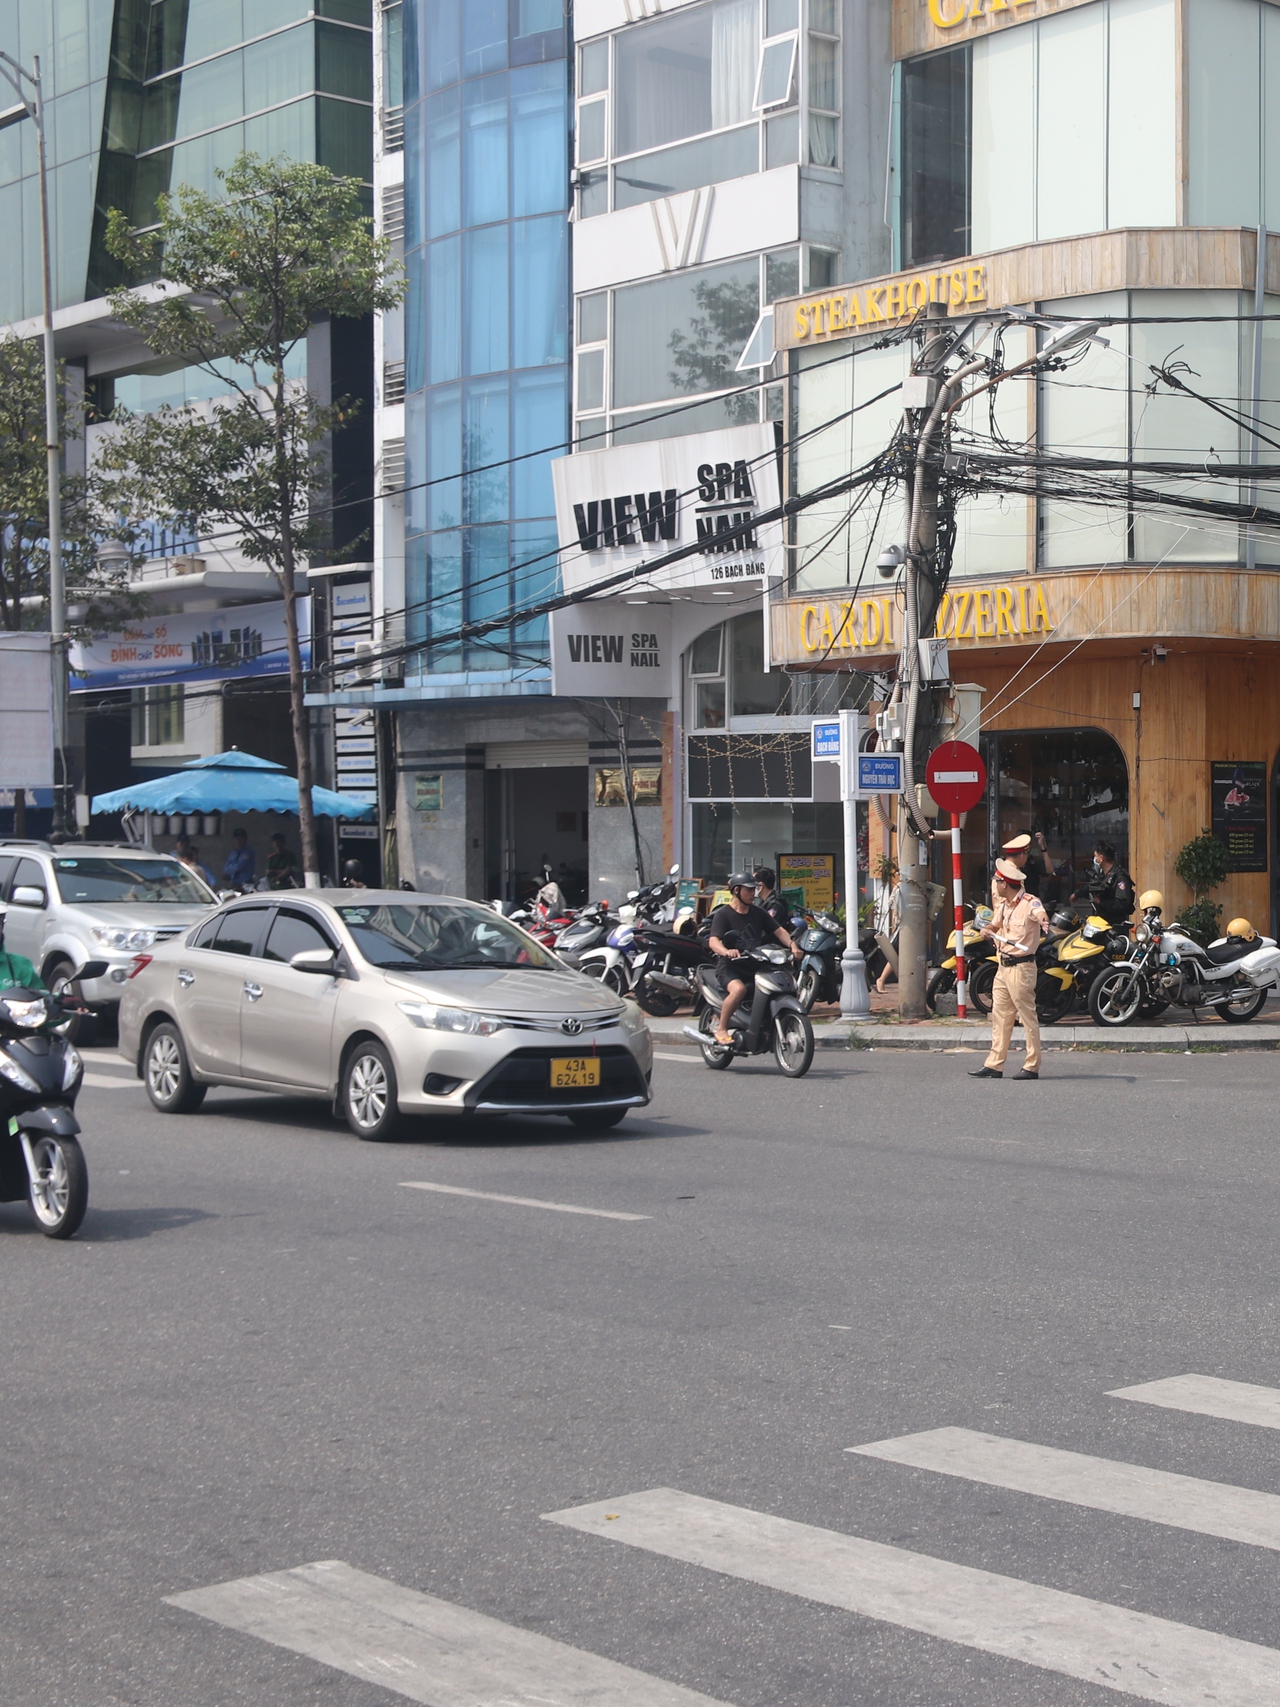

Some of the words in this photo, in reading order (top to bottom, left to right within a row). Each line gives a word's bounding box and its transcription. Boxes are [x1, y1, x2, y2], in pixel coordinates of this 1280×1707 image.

[794, 265, 985, 339] STEAKHOUSE
[697, 459, 755, 503] SPA
[573, 488, 682, 552] VIEW
[696, 511, 761, 555] NAIL
[710, 568, 724, 580] 126
[800, 598, 895, 651] CARDI
[110, 642, 137, 663] ĐỈNH
[153, 640, 184, 659] SỐNG
[567, 634, 624, 663] VIEW
[631, 633, 658, 648] SPA
[630, 652, 661, 667] NAIL
[874, 761, 895, 770] ĐƯỜNG
[565, 1059, 586, 1071] 43A
[556, 1072, 595, 1086] 624.19
